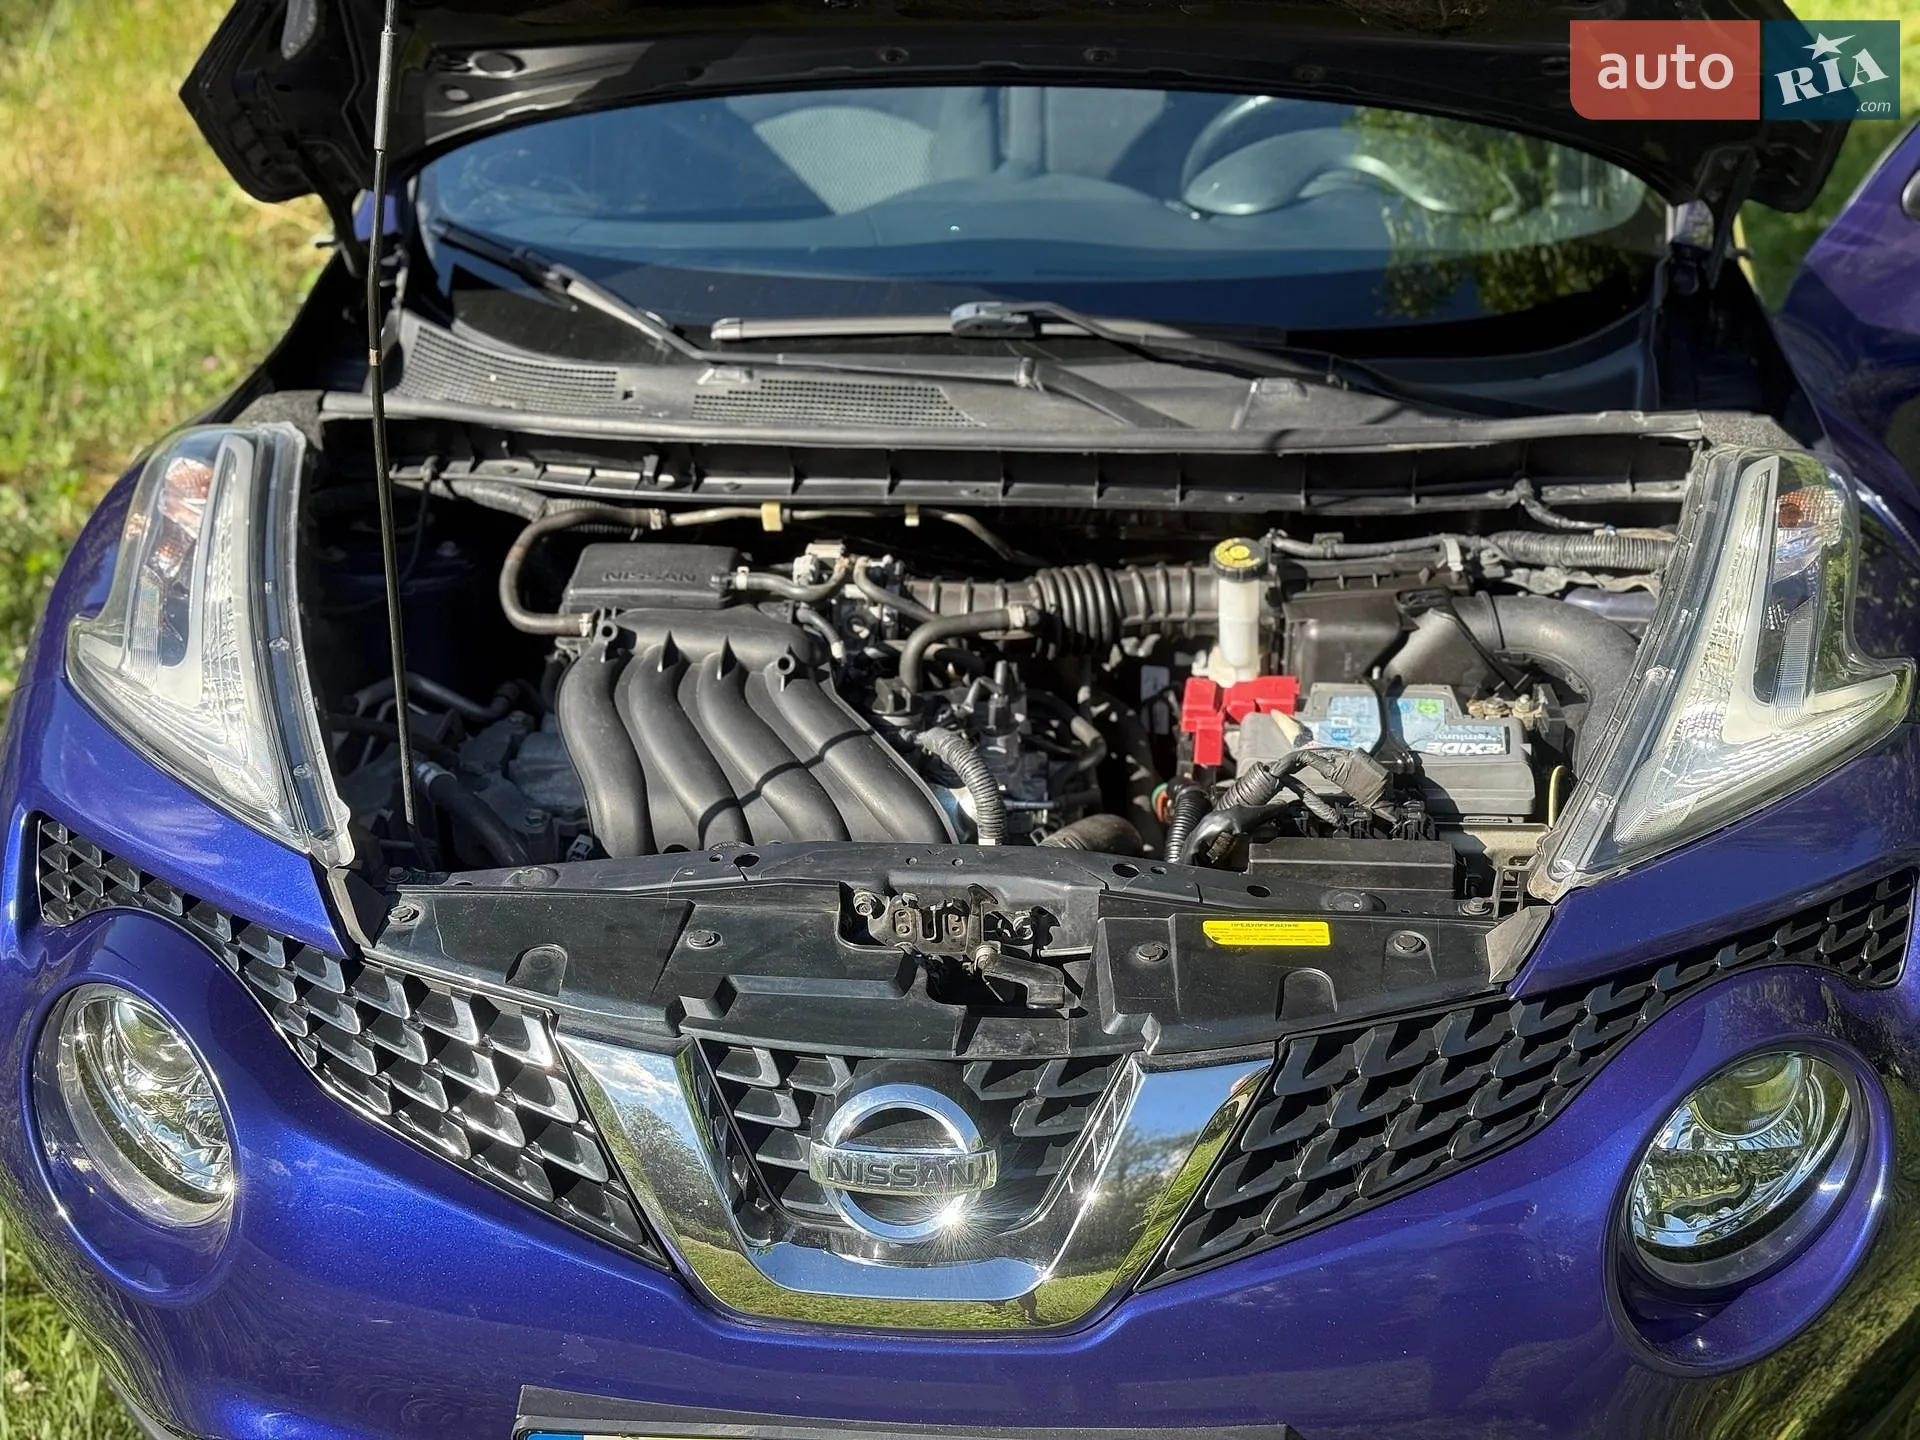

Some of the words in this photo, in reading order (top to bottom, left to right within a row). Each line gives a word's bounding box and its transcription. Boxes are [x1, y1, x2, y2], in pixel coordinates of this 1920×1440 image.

[602, 571, 697, 583] NISSAN
[1426, 742, 1504, 755] EXIDE
[828, 1157, 974, 1187] NISSAN
